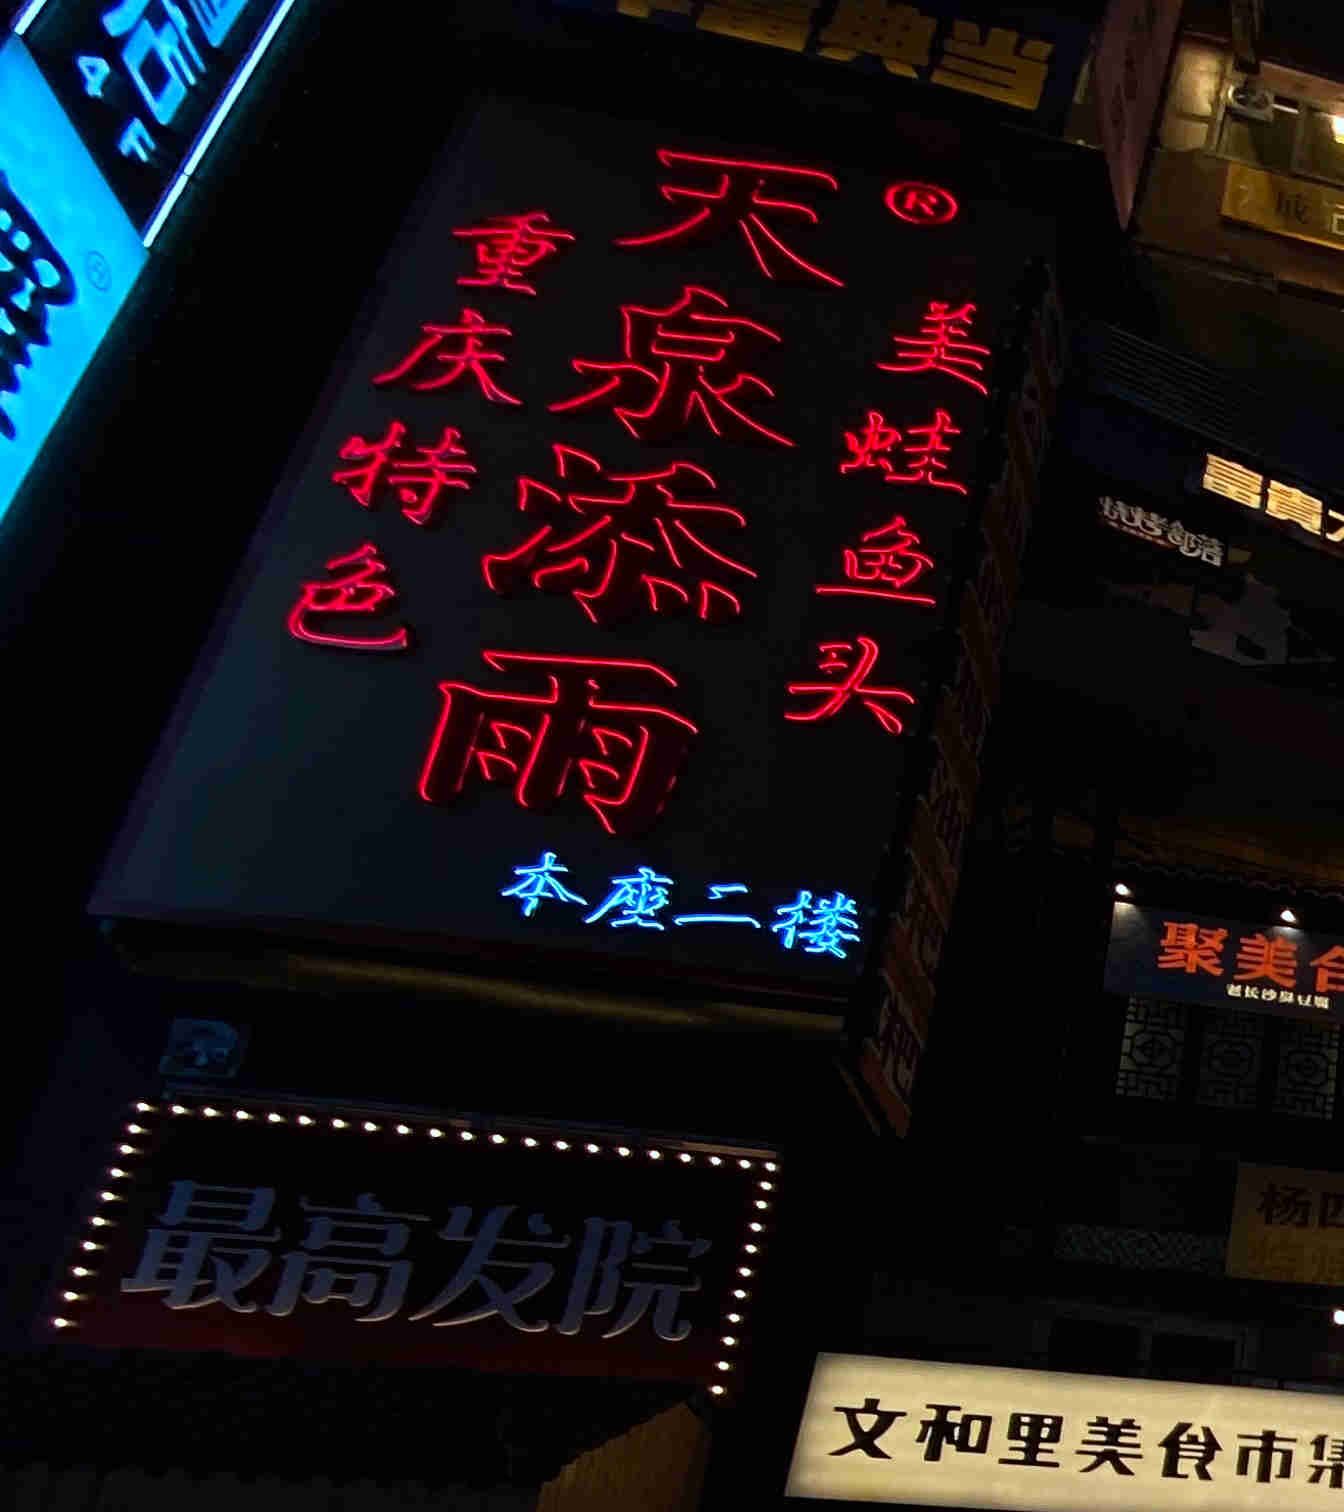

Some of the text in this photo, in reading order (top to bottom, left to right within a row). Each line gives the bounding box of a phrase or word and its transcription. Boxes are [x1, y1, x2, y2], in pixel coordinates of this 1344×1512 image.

[287, 210, 576, 651] 重庆特色
[785, 302, 991, 733] 美蛙鱼头
